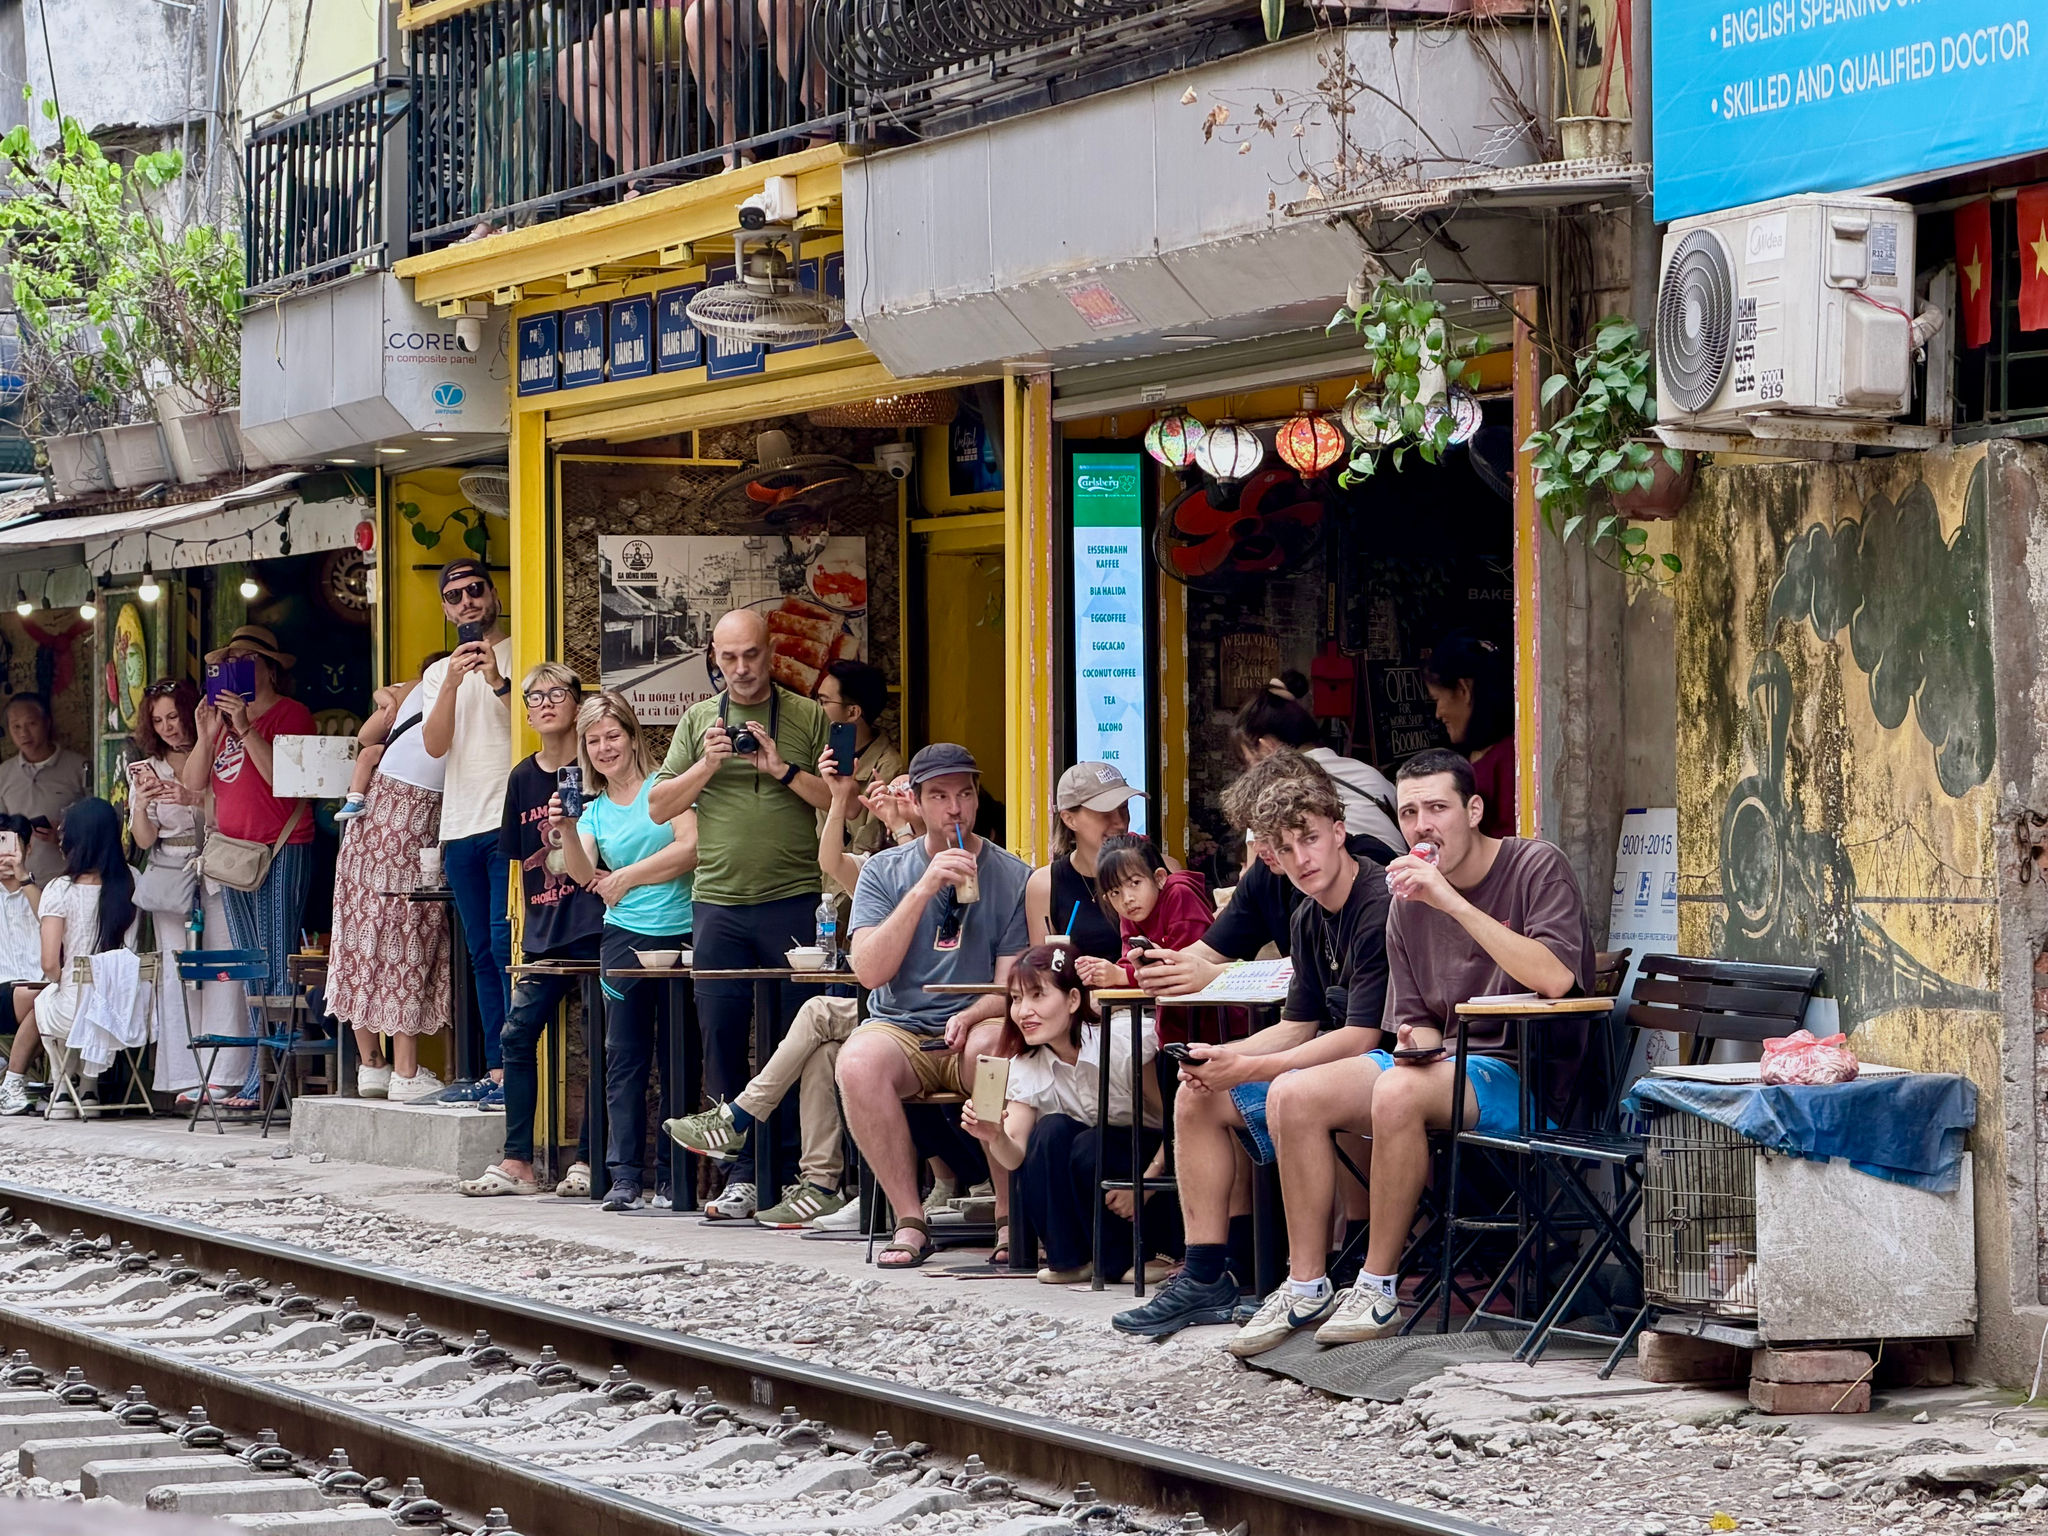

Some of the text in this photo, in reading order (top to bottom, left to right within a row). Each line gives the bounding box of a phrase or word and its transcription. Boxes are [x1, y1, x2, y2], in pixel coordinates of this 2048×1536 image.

[1722, 2, 1796, 48] ENGLISH
[1723, 19, 2030, 120] SKILLED AND QUALIFIED DOCTOR
[384, 333, 455, 350] CORE
[662, 325, 680, 357] HÀNG
[397, 354, 447, 366] composite
[450, 354, 477, 365] panel
[614, 337, 632, 366] HÀNG
[521, 355, 538, 382] HÀNG
[565, 347, 582, 375] HÀNG
[1760, 383, 1784, 400] 619
[1077, 475, 1119, 492] Carlsberg
[1096, 559, 1120, 568] KAFFEE
[1089, 587, 1126, 595] BIA HALIDA
[1090, 613, 1126, 622] EGGCOFFEE
[1092, 641, 1126, 650] EGGCACAO
[1223, 633, 1278, 649] WELCOME
[1082, 668, 1137, 678] COCONUT COFFEE
[1385, 670, 1424, 703] OPEN
[1103, 696, 1116, 705] TEA
[1398, 702, 1412, 714] FOR
[1097, 722, 1123, 732] ALCOHO
[1101, 750, 1120, 760] JUICE
[521, 805, 549, 825] I AM
[1621, 834, 1673, 855] 9001-2015
